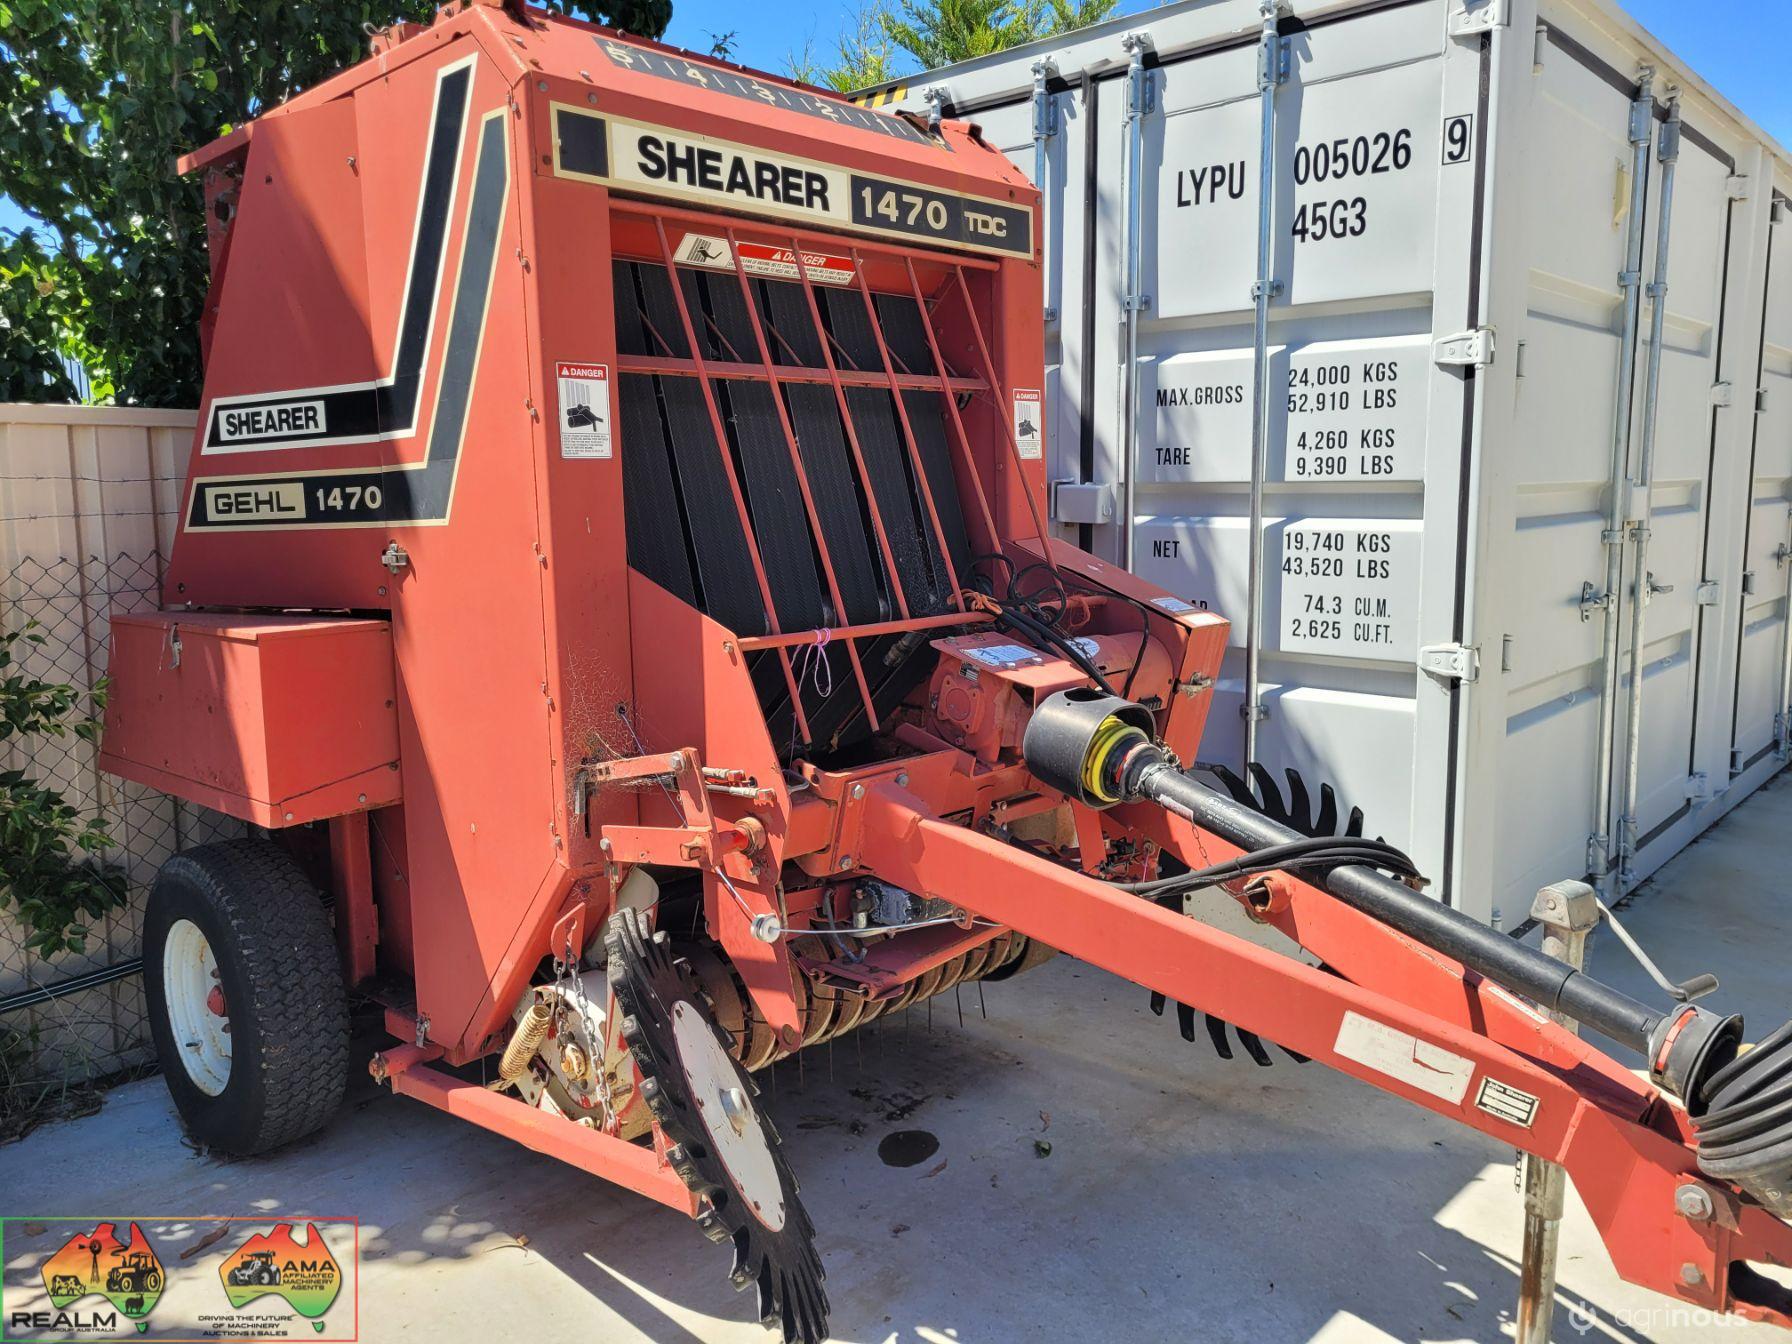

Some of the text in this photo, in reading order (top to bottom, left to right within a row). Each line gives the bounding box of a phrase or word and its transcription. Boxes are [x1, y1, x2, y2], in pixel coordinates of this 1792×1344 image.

[686, 67, 708, 83] 4
[752, 84, 776, 101] 3
[813, 102, 839, 119] 2
[1293, 118, 1468, 186] 005026 9
[637, 135, 1007, 238] SHEARER 1470 TDC
[1177, 160, 1246, 208] LYPU
[1292, 197, 1367, 243] 45G3
[570, 368, 604, 378] DANGER
[1288, 361, 1398, 388] 24,000 KGS
[1156, 385, 1244, 407] MAX.GROSS
[1288, 389, 1397, 415] 52,910 LBS
[225, 405, 319, 437] SHEARER
[1297, 428, 1396, 452] 4,260 KGS
[1155, 448, 1191, 466] TARE
[1296, 455, 1395, 477] 9,390 LBS
[214, 485, 382, 514] GEHL 1470
[1153, 540, 1180, 558] NET
[1285, 532, 1392, 553] 19,740 KGS
[1282, 556, 1391, 579] 43,520 LBS
[1304, 594, 1392, 619] 74.3 CU.M.
[1291, 618, 1394, 645] 2,625 CU.FT.
